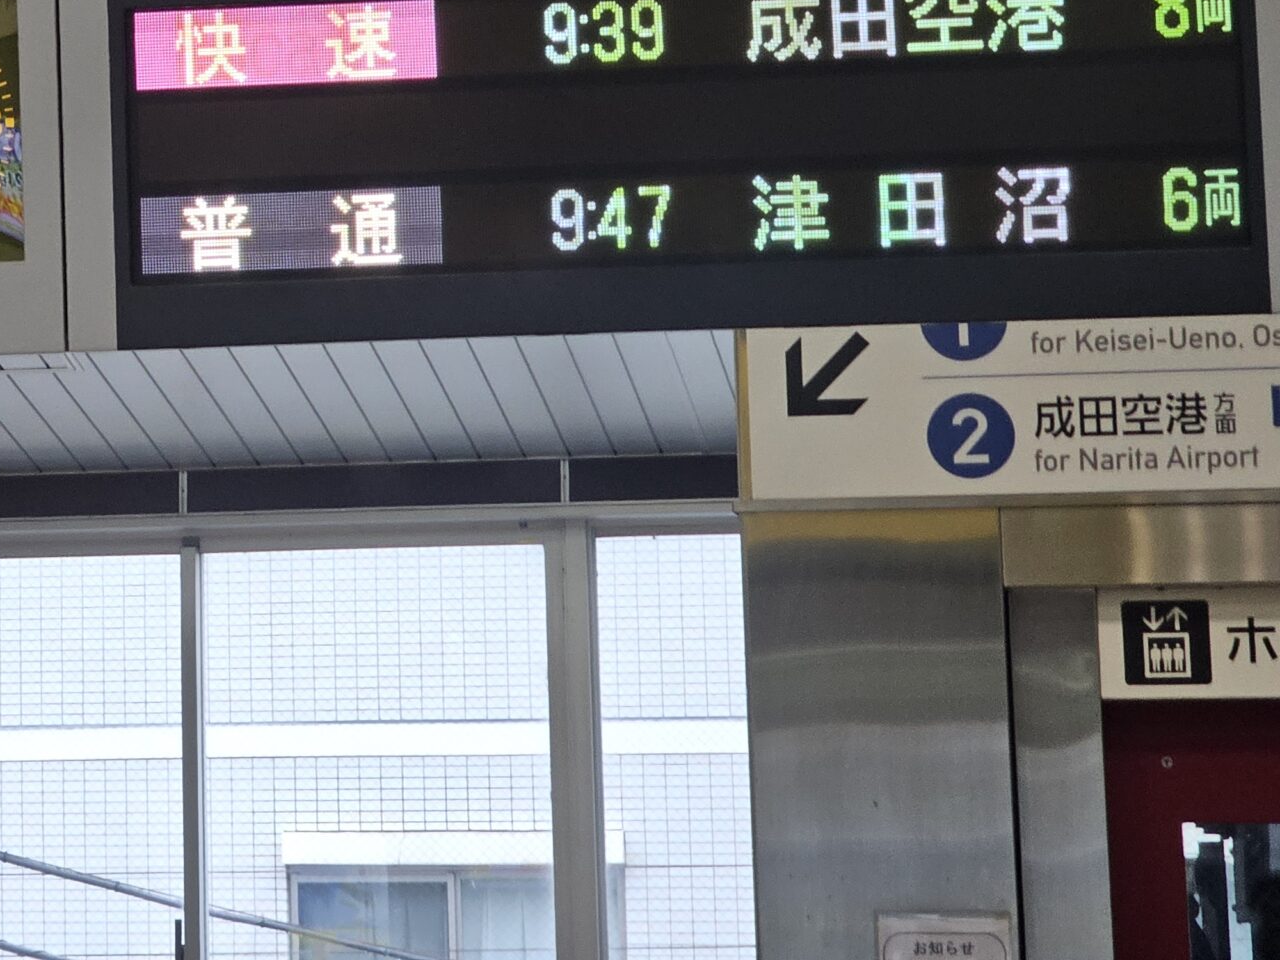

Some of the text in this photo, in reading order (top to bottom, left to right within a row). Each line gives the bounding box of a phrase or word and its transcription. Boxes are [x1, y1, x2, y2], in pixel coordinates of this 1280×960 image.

[175, 3, 398, 86] 快速
[180, 166, 1242, 273] 普通 9:47 津田沼 6両
[1031, 330, 1066, 354] for
[1075, 326, 1244, 353] Keisei-Ueno,
[951, 408, 990, 466] 2
[1034, 443, 1259, 475] for Narita Airport
[1226, 615, 1278, 664] ホ
[913, 941, 975, 956] お知らせ
